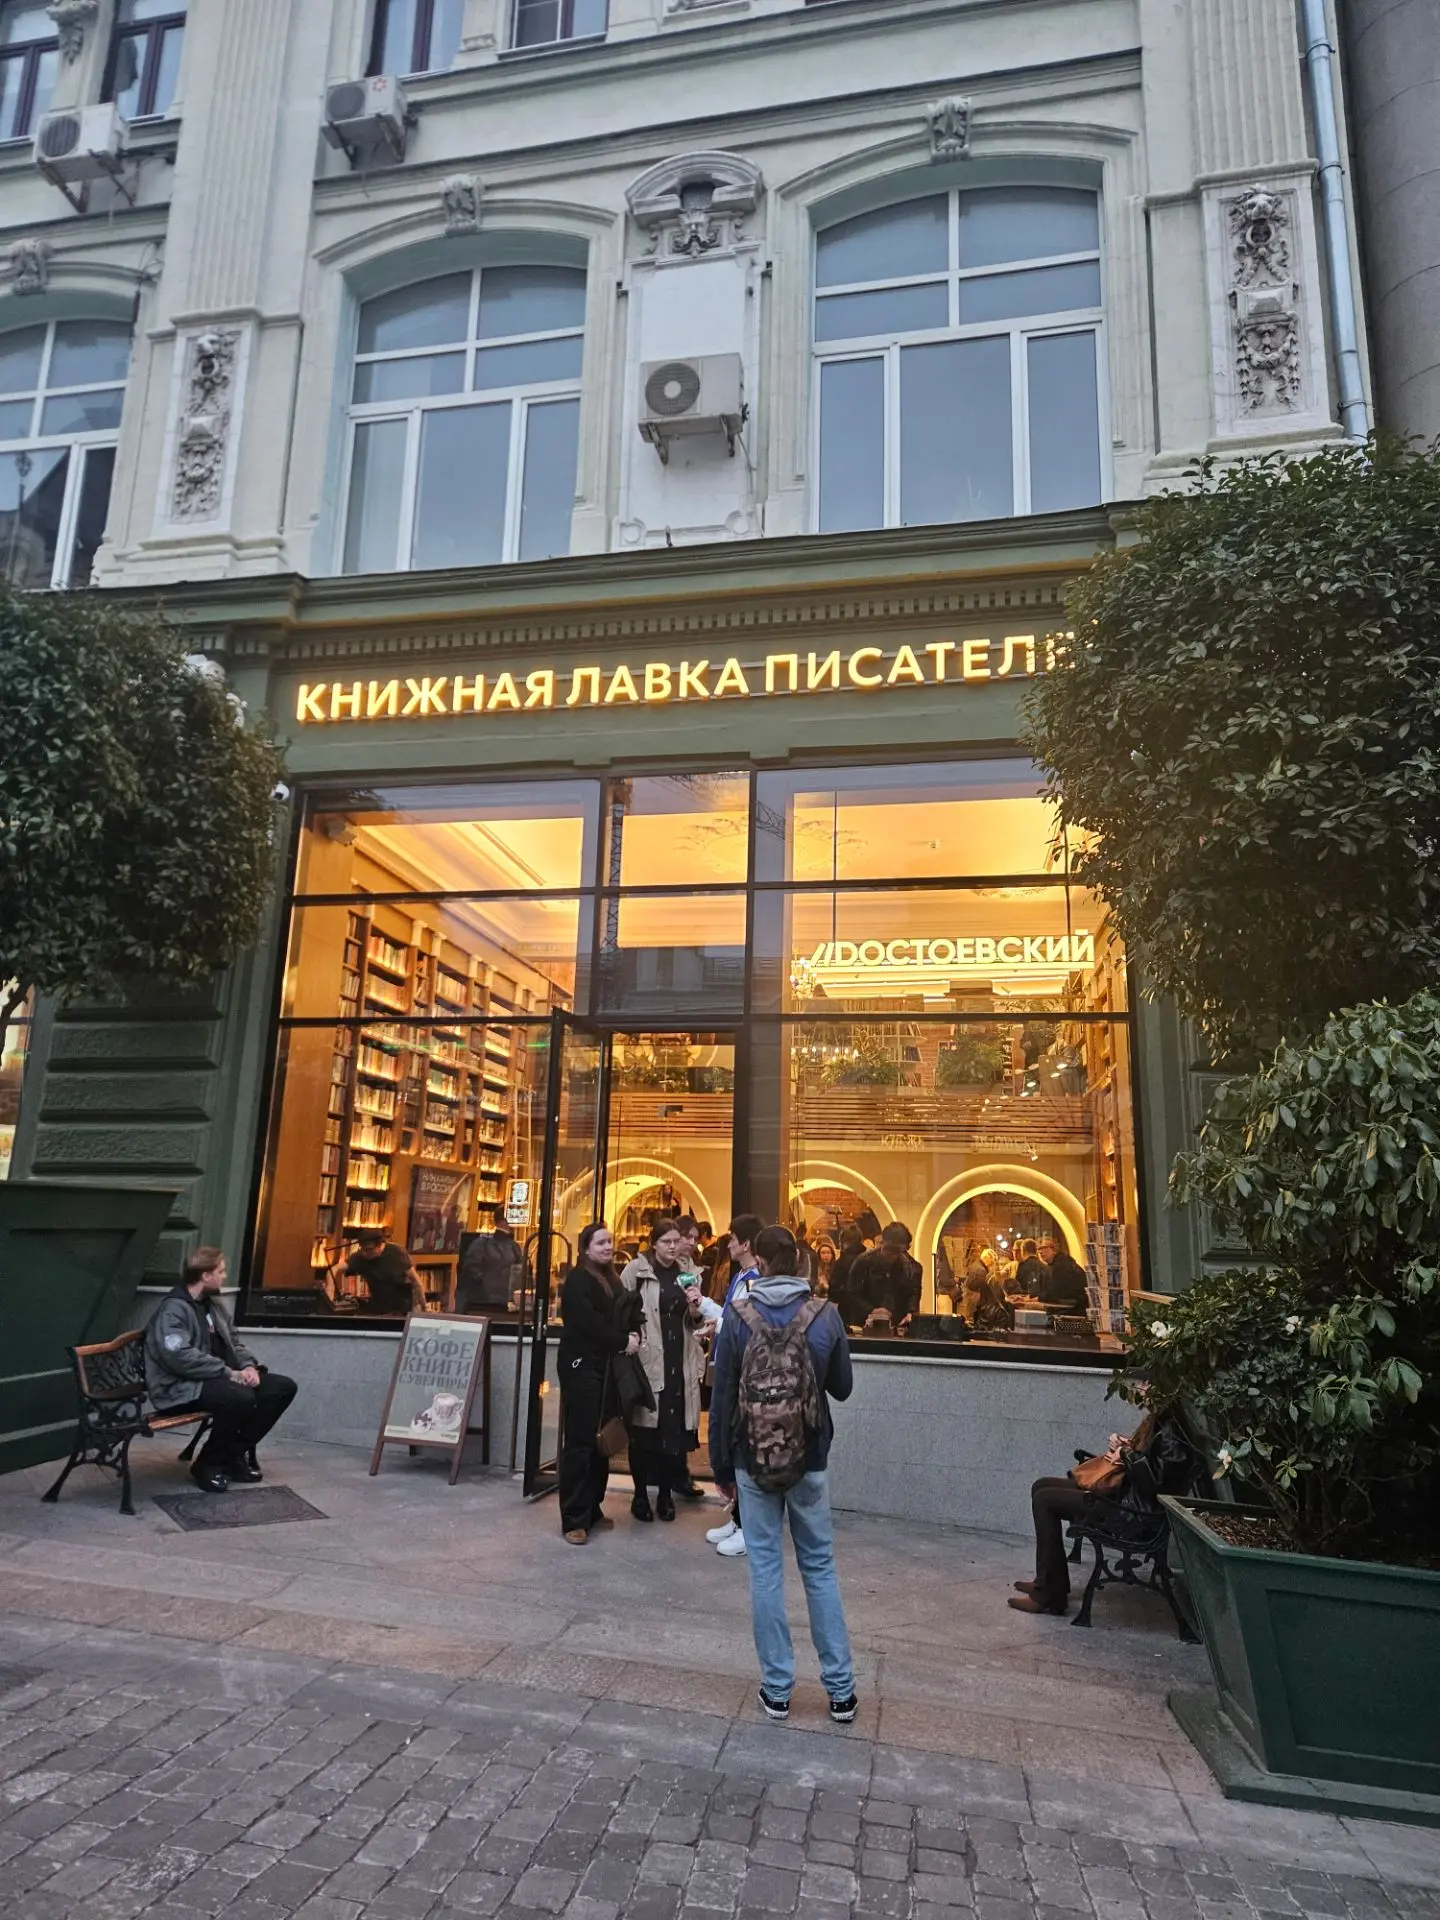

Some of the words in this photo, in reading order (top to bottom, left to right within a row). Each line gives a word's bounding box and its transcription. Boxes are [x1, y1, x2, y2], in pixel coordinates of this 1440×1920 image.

[297, 670, 554, 721] КНИЖНАЯ
[566, 658, 749, 704] ЛАВКА
[407, 1337, 474, 1360] КОФЕ
[402, 1356, 471, 1377] КНИГИ
